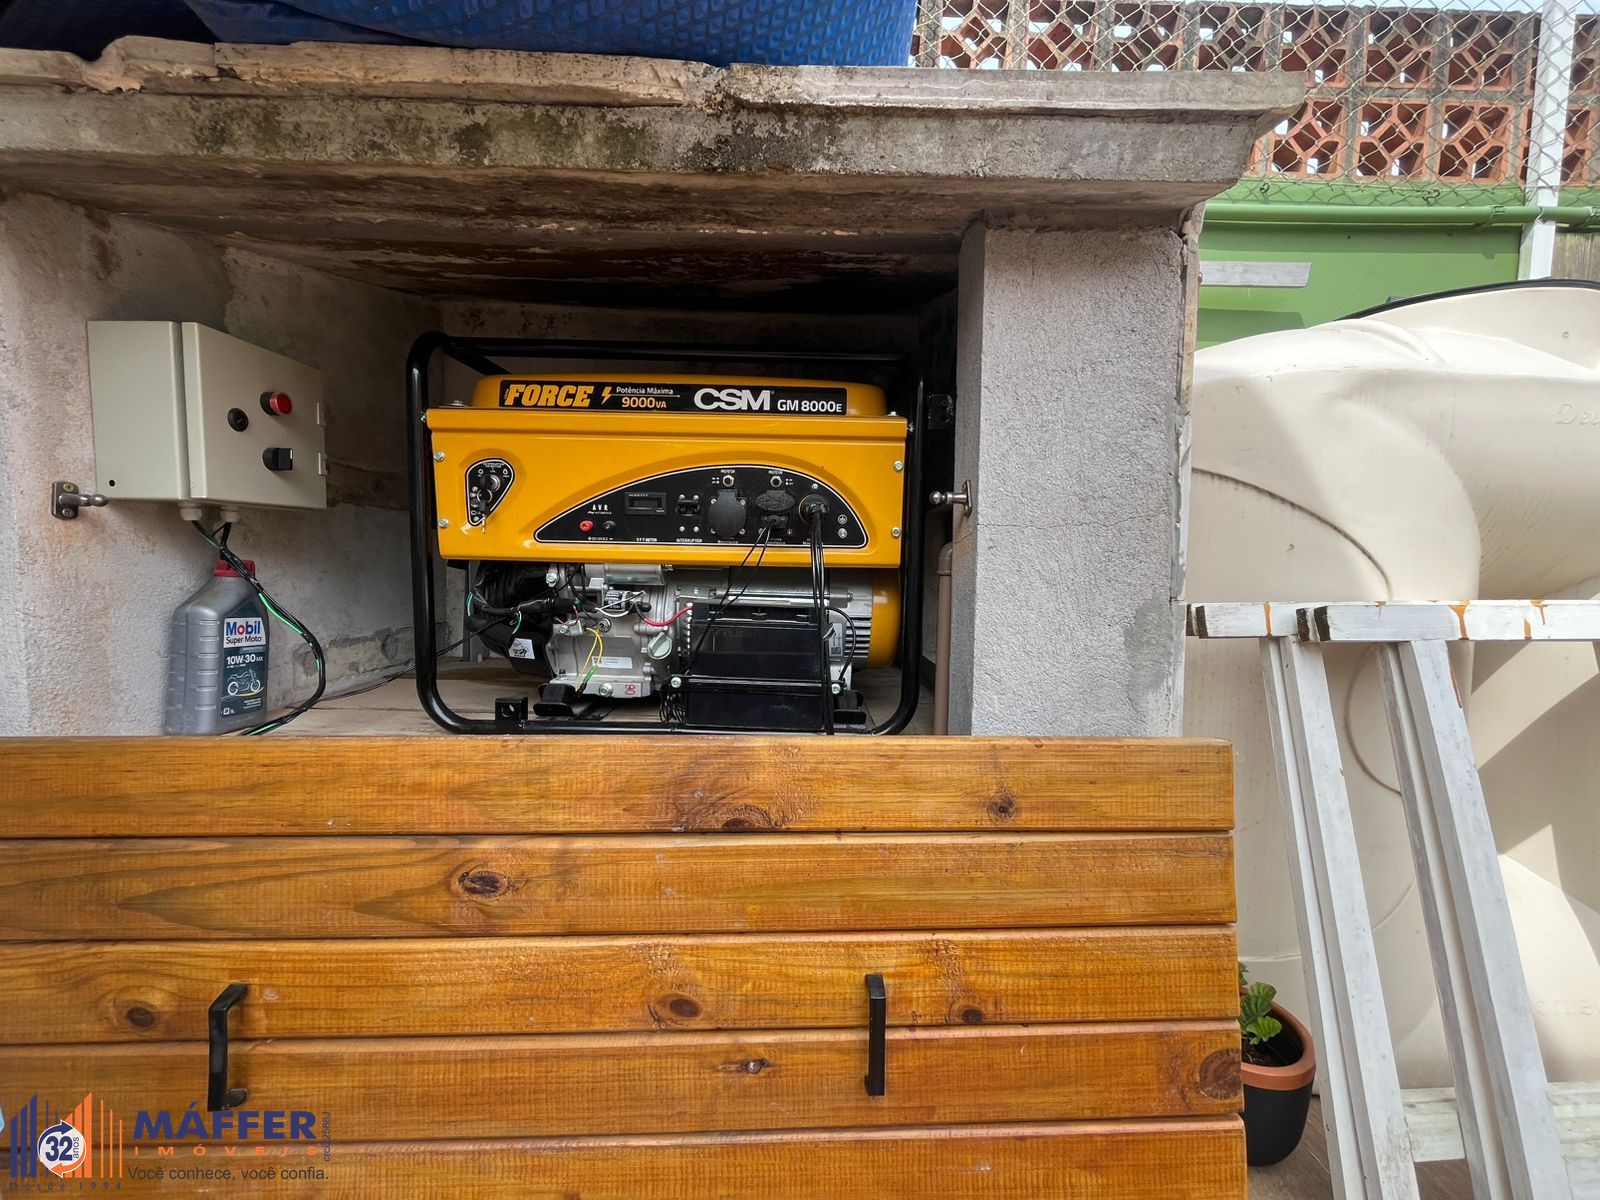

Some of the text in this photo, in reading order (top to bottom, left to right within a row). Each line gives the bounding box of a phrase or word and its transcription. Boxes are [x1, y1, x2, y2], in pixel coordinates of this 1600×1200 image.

[504, 384, 595, 407] FORCE
[616, 386, 674, 395] Potência Máxima
[693, 388, 771, 411] CSM
[777, 399, 843, 413] GM 8000E
[225, 620, 261, 636] Mobil
[226, 635, 262, 645] Super Moto
